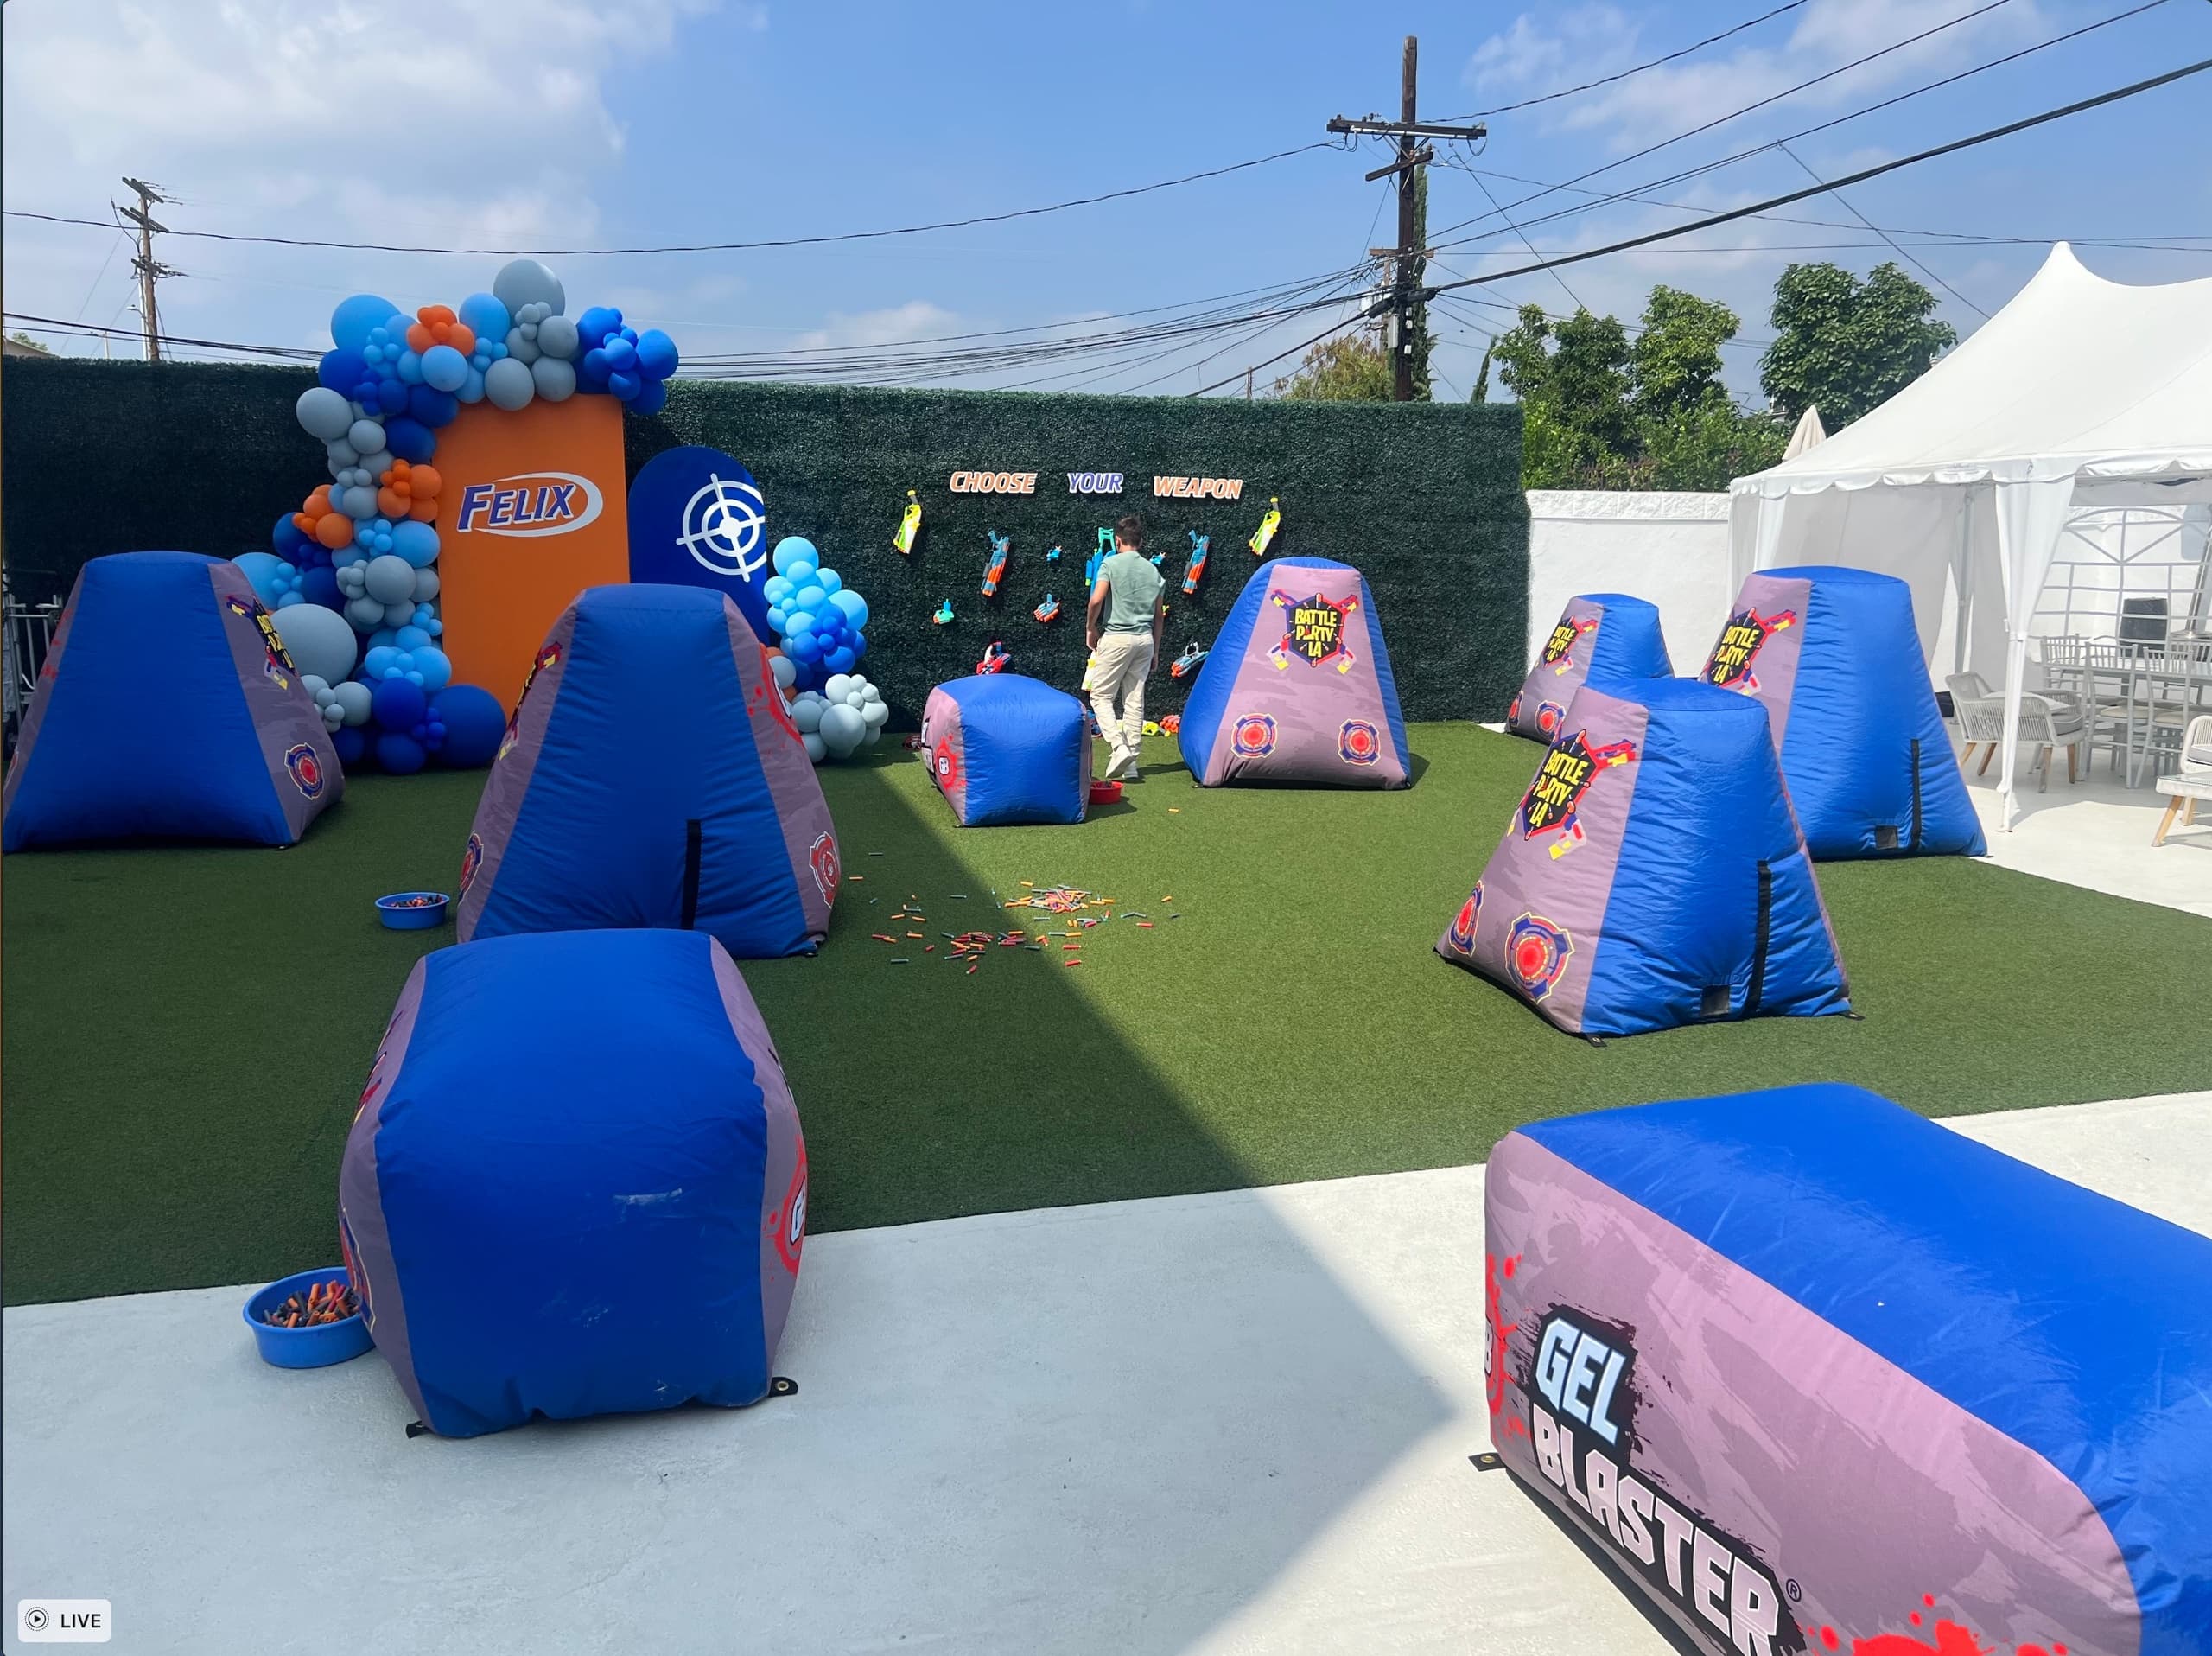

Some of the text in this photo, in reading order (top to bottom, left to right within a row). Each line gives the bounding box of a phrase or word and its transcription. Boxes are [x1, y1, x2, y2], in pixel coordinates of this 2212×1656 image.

[950, 471, 1243, 500] CHOOSE YOUR WEAPON
[456, 483, 575, 533] FELIX
[1294, 608, 1338, 627] BATTLE
[1295, 625, 1334, 642] PARTY
[1307, 641, 1322, 658] LA
[1543, 749, 1589, 786] BATTLE
[1529, 800, 1550, 828] LA
[1535, 1316, 1626, 1445] GEL
[1532, 1402, 1780, 1656] BLASTER
